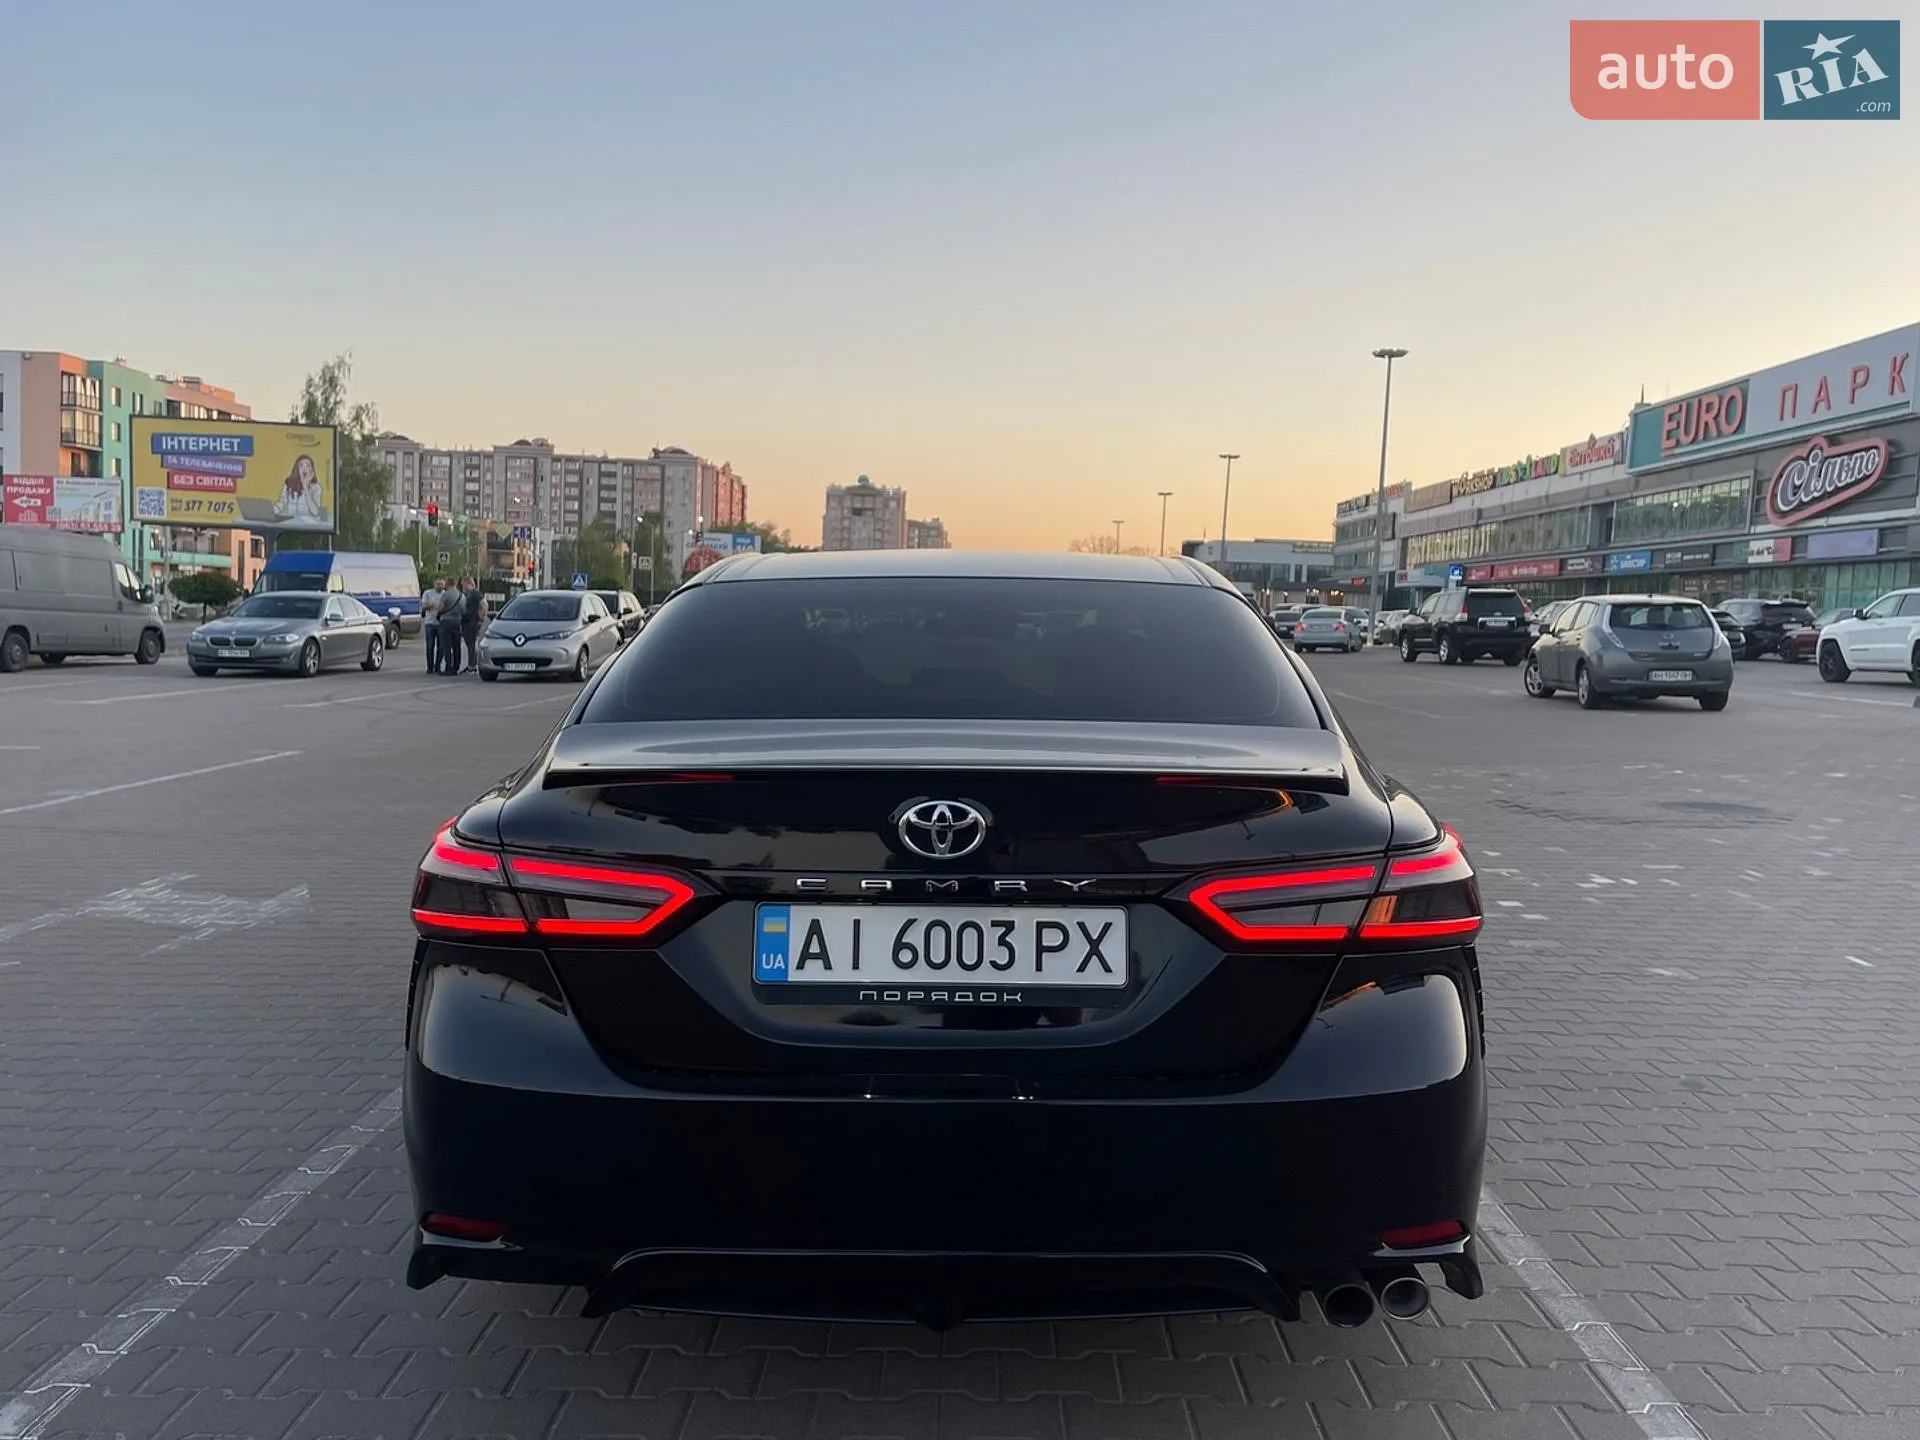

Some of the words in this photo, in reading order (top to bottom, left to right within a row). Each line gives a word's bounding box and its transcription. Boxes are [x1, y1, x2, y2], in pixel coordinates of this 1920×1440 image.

[1660, 386, 1745, 450] EURO
[1778, 352, 1909, 422] ПАРК
[162, 436, 241, 452] ІНТЕРНЕТ
[167, 455, 178, 465] ТА
[180, 457, 243, 473] ТЕЛЕБАЧЕННЯ
[13, 477, 44, 485] ВІДДІЛ
[173, 475, 194, 485] БЕЗ
[196, 475, 234, 488] СВІТЛА
[6, 487, 51, 495] ПРОДАЖУ
[184, 500, 203, 512] 377
[796, 878, 1096, 892] CAMRY
[762, 954, 785, 970] UA
[796, 918, 861, 970] AI
[891, 918, 1016, 972] 6003
[1035, 921, 1114, 974] PX
[859, 990, 1022, 1003] ПОРЯДОК
